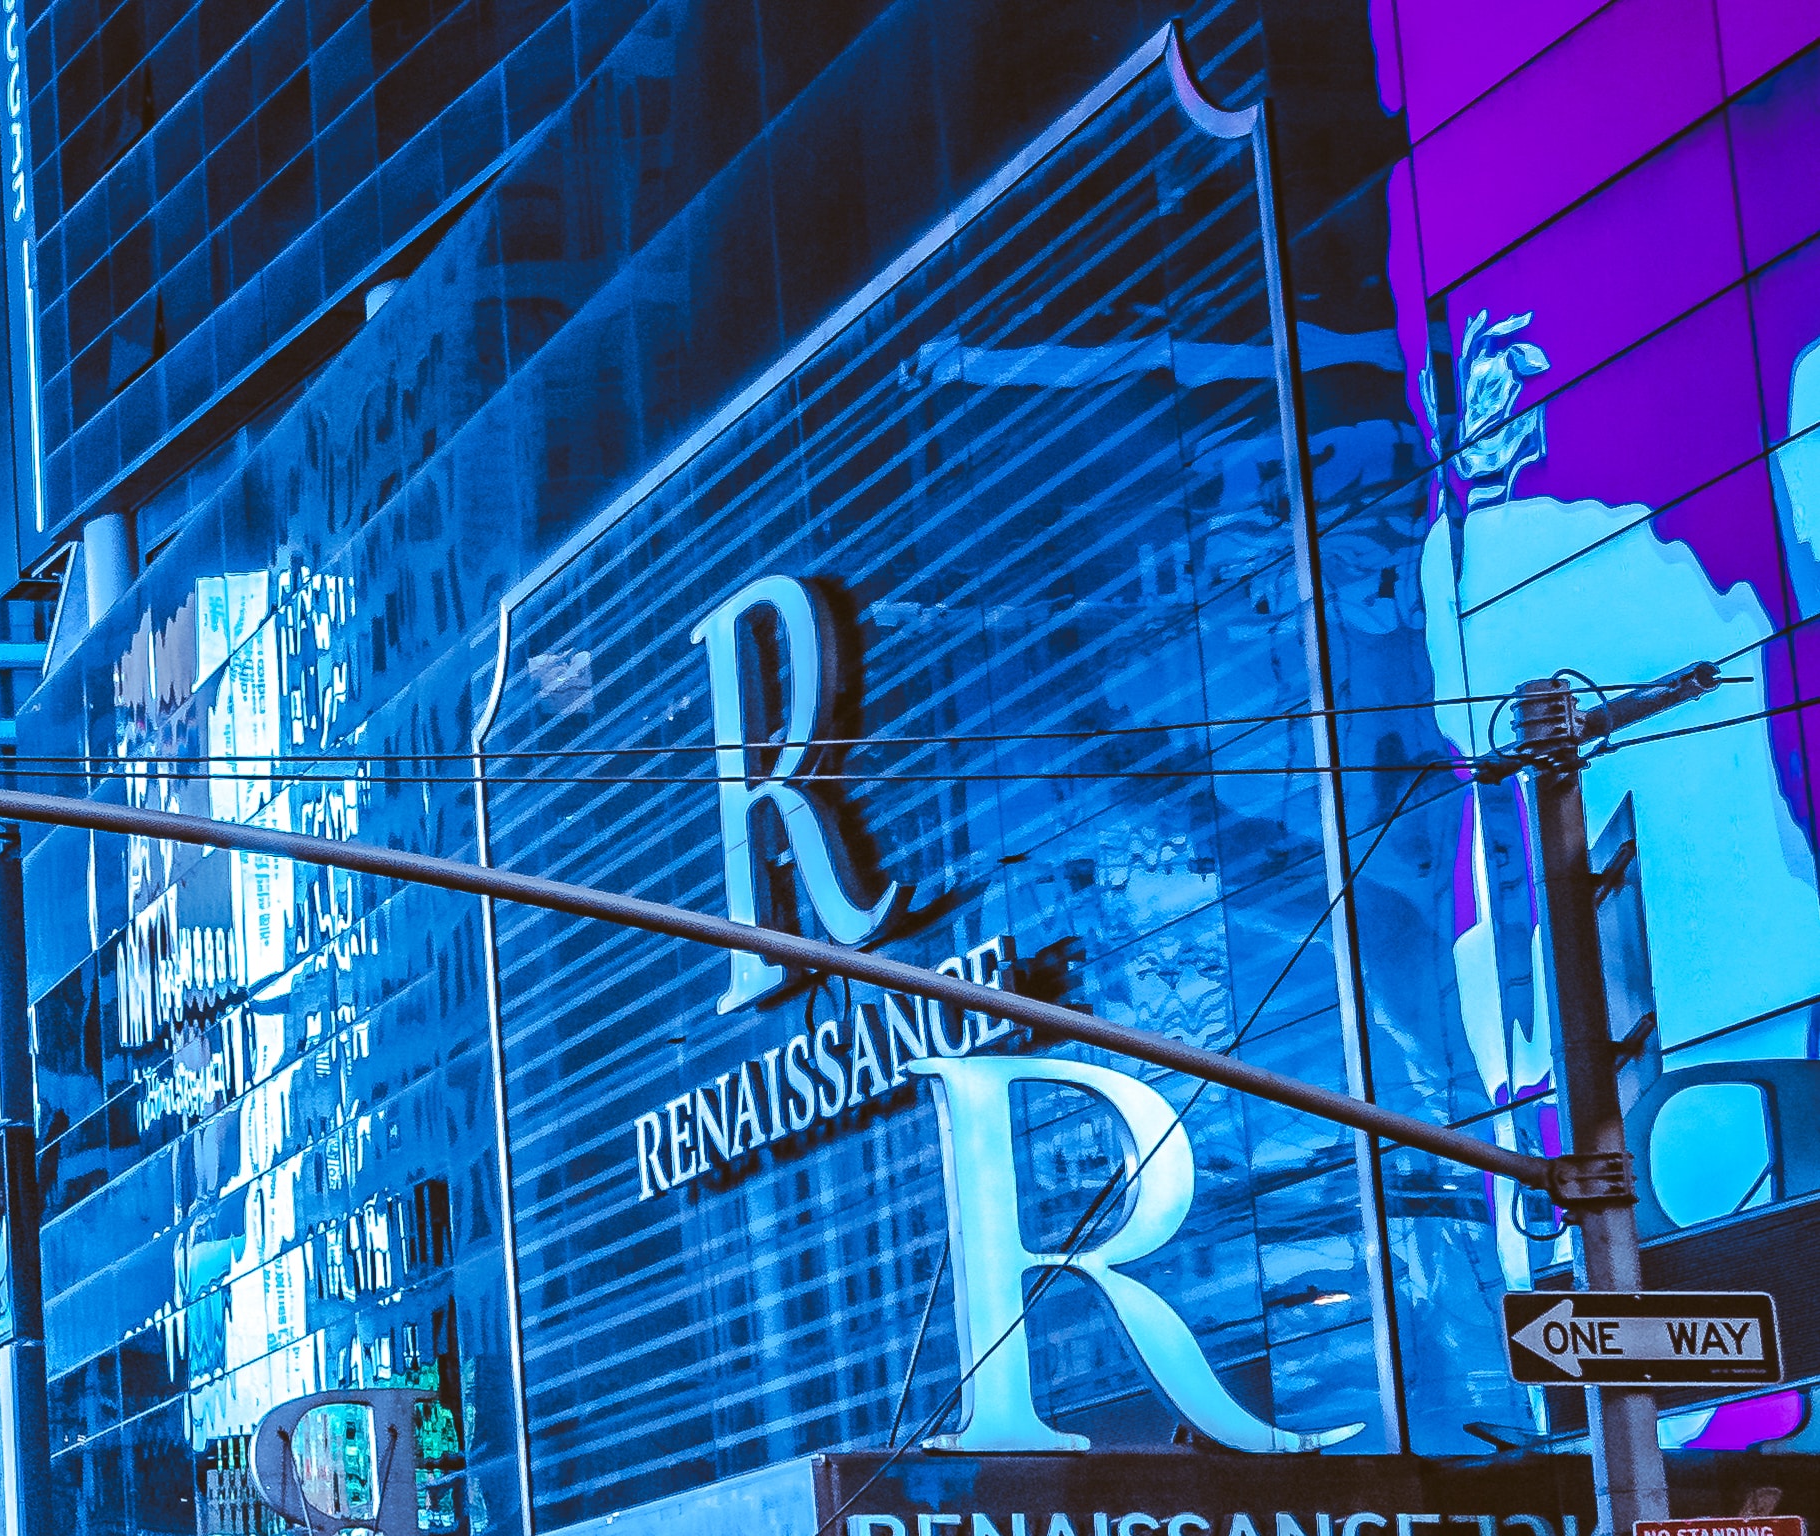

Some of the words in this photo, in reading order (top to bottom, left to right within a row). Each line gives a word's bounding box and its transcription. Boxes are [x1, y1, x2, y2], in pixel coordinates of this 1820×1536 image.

[690, 574, 898, 1016] R
[633, 934, 1016, 1202] RENAISSANCE
[907, 1055, 1367, 1454] R
[1542, 1321, 1624, 1356] ONE
[1666, 1321, 1751, 1356] WAY
